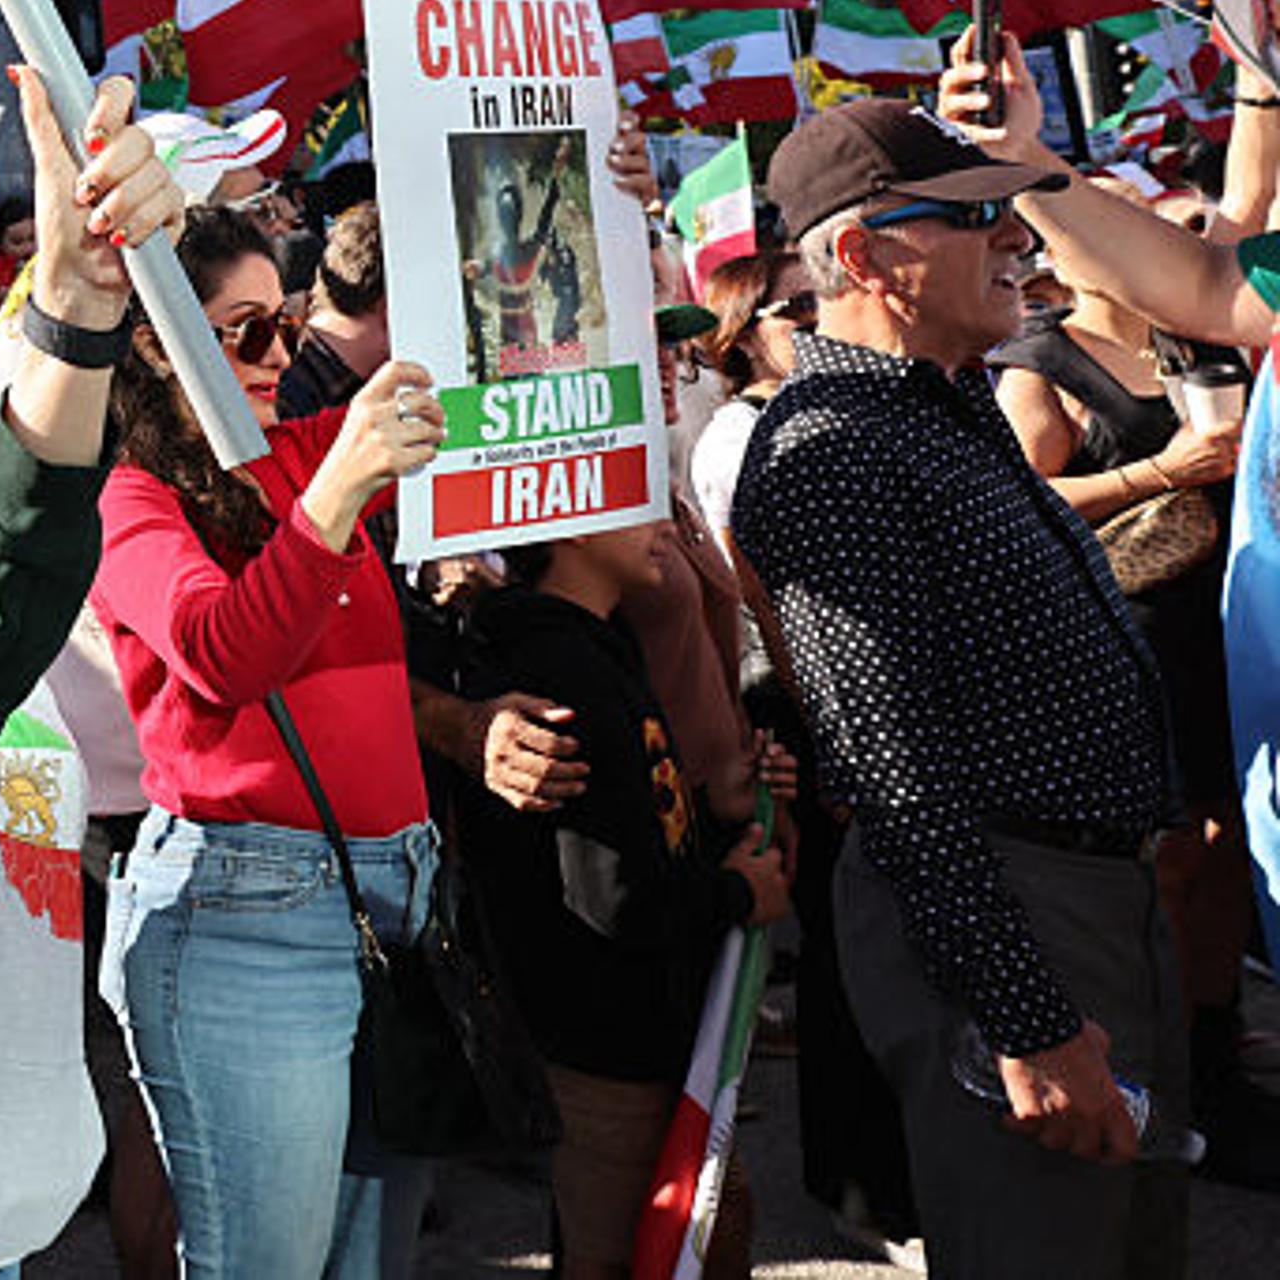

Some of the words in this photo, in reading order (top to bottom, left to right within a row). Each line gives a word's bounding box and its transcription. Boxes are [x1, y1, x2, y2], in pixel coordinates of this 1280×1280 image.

[470, 86, 501, 129] in
[510, 84, 573, 127] IRAN
[480, 371, 613, 441] STAND
[491, 454, 605, 525] IRAN
